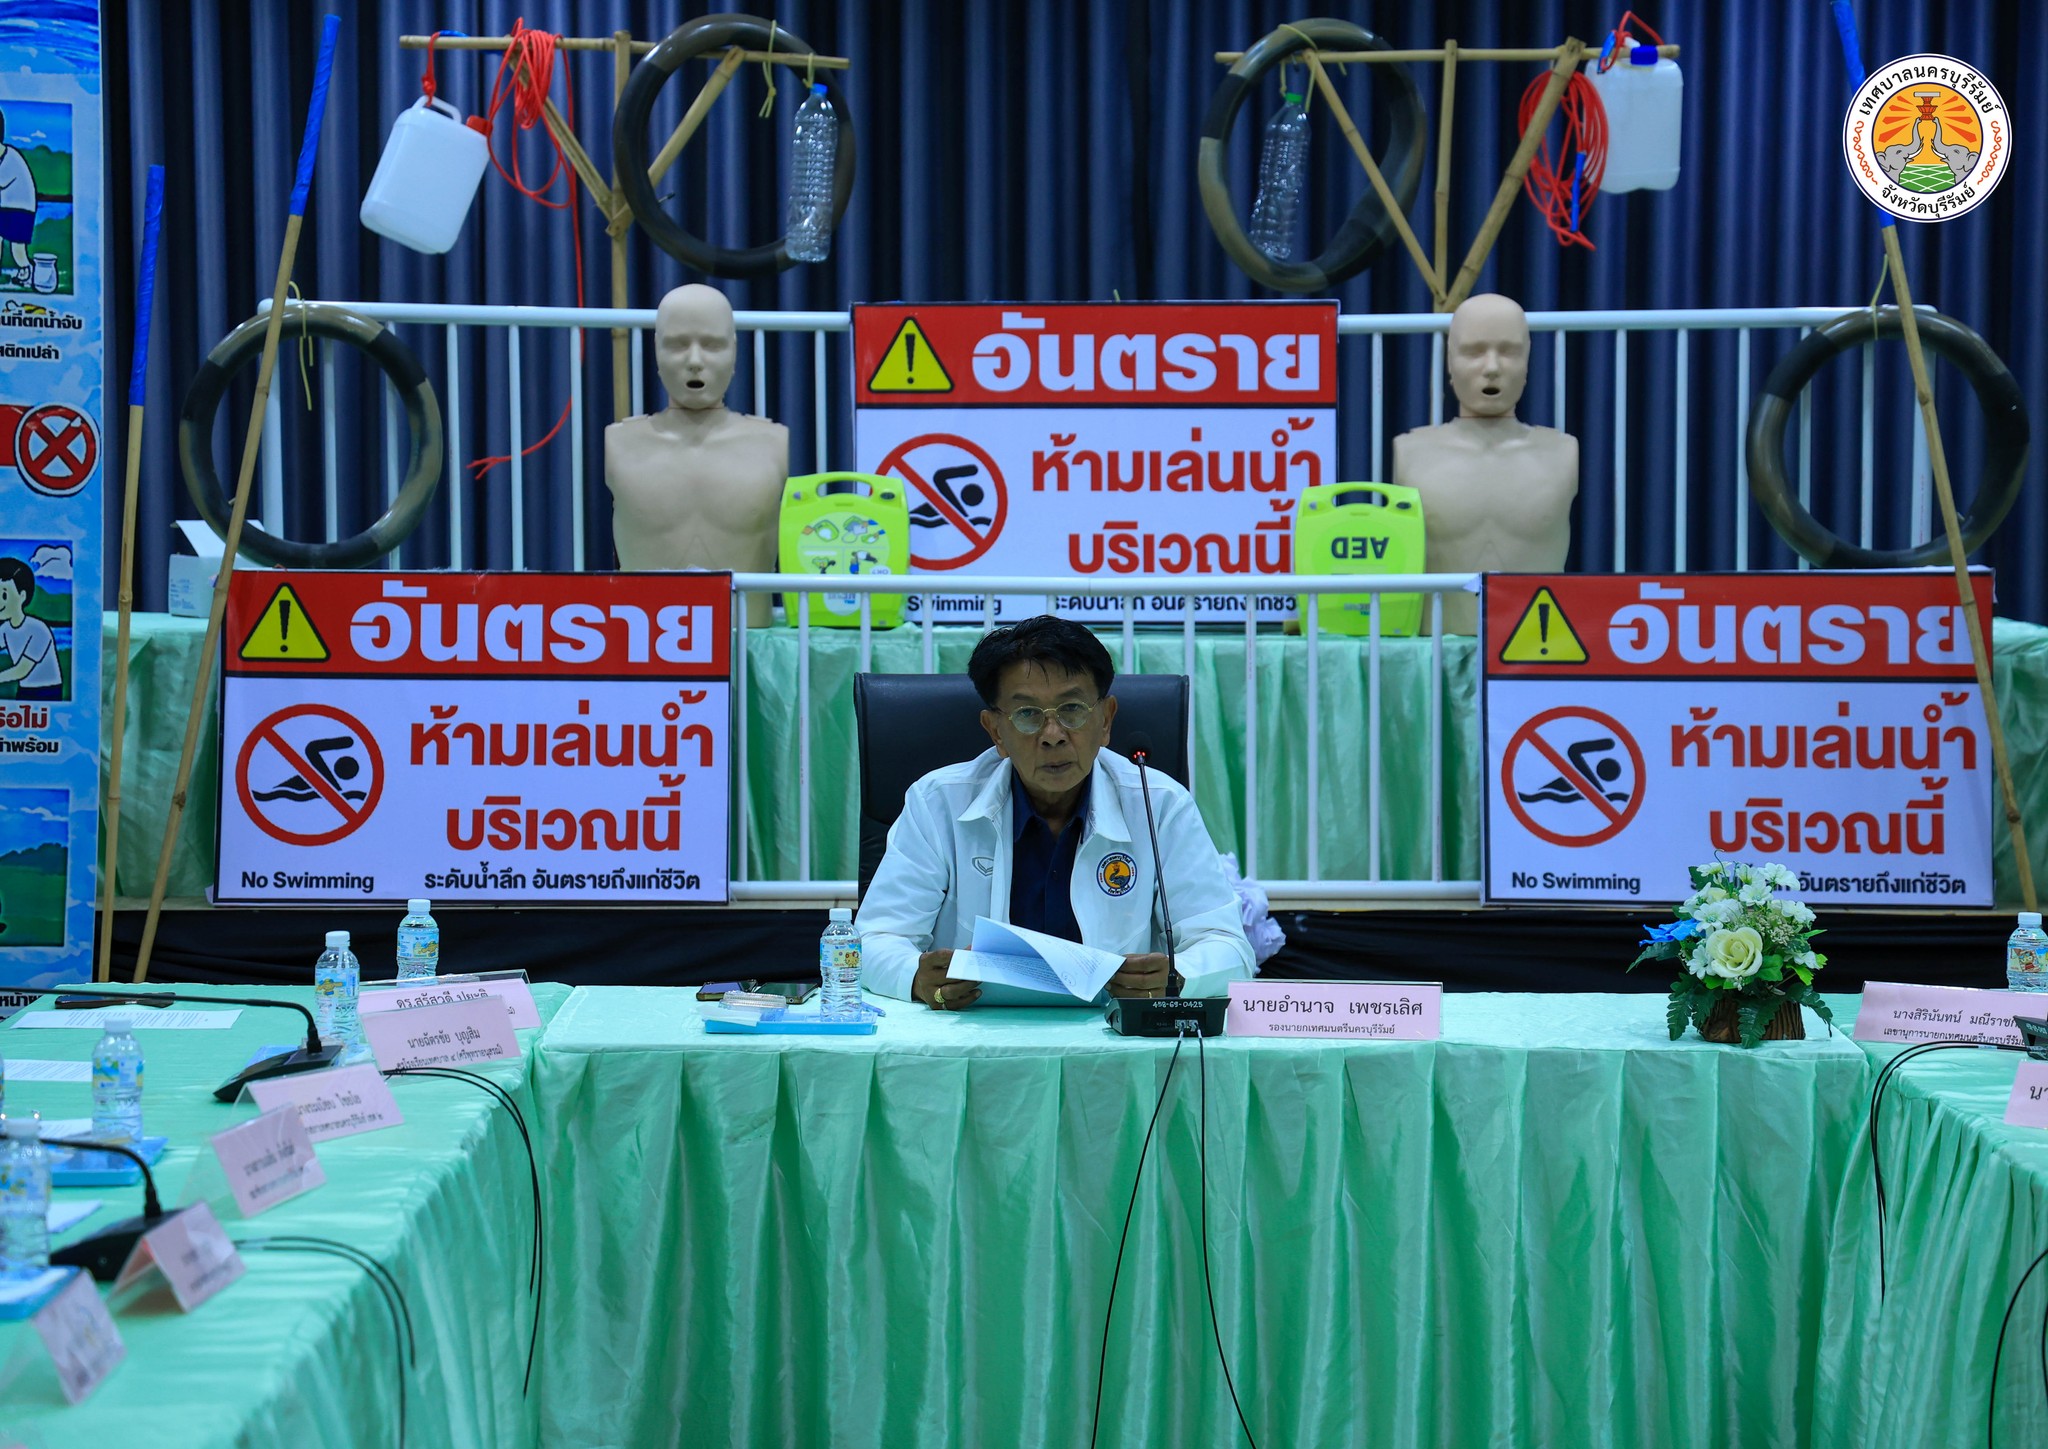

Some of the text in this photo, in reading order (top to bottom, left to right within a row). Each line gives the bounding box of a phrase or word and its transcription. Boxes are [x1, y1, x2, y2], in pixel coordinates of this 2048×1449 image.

[972, 312, 1320, 392] อันตราย
[1032, 417, 1322, 493] ห้ามเล่นน้ำ
[1069, 499, 1296, 574] บริเวณนี้
[1331, 537, 1390, 559] AED
[350, 580, 713, 663] อันตราย
[907, 596, 1002, 615] Simmig
[1608, 582, 1974, 665] อันตราย
[411, 690, 713, 767] ห้ามเล่นน้ำ
[1671, 692, 1976, 770] ห้ามเล่นน้ำ
[447, 774, 686, 851] บริเวณนี้
[1710, 777, 1947, 855] บริเวณนี้
[241, 871, 375, 893] No Swimming
[424, 861, 701, 890] ระดับน้ำลึก อันตรายถึงแก่ชีวิต
[1512, 871, 1641, 895] No Swimming
[1798, 871, 1967, 894] อันตรายถึงแก่ชีวิต
[1243, 994, 1424, 1017] นายอำนาจ เพชรเลิศ
[1268, 1022, 1396, 1036] รองนายกเทศมนตรีนครบุรีรัมย์
